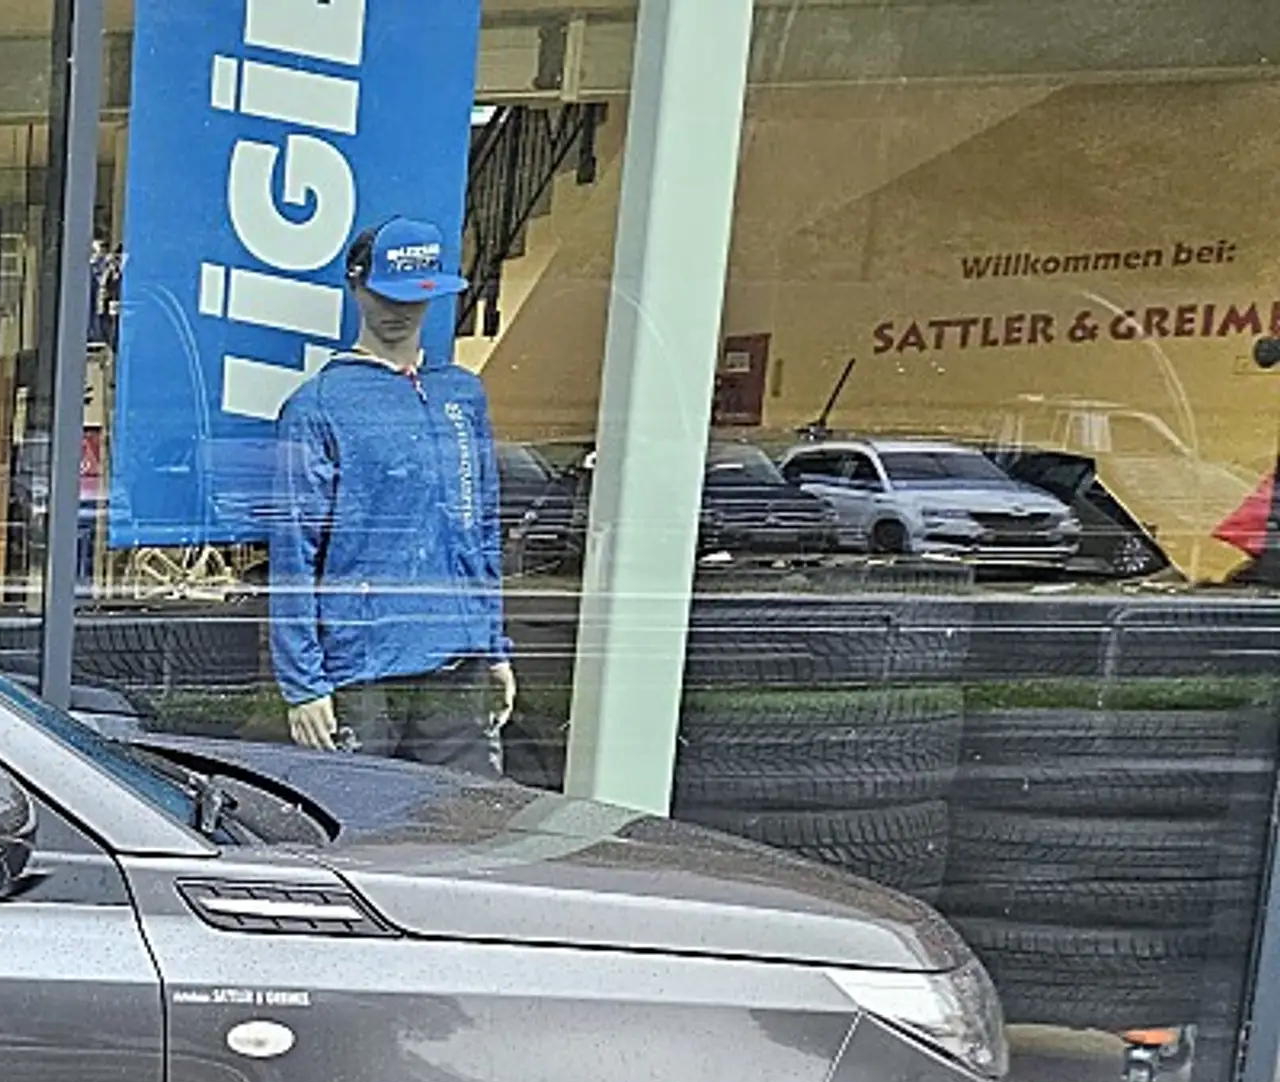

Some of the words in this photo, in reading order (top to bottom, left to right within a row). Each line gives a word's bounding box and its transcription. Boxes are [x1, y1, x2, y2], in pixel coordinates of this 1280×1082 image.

[960, 245, 1163, 280] Willkommen
[1171, 240, 1237, 267] bei:
[872, 312, 1056, 356] SATTLER
[1067, 310, 1100, 345] &
